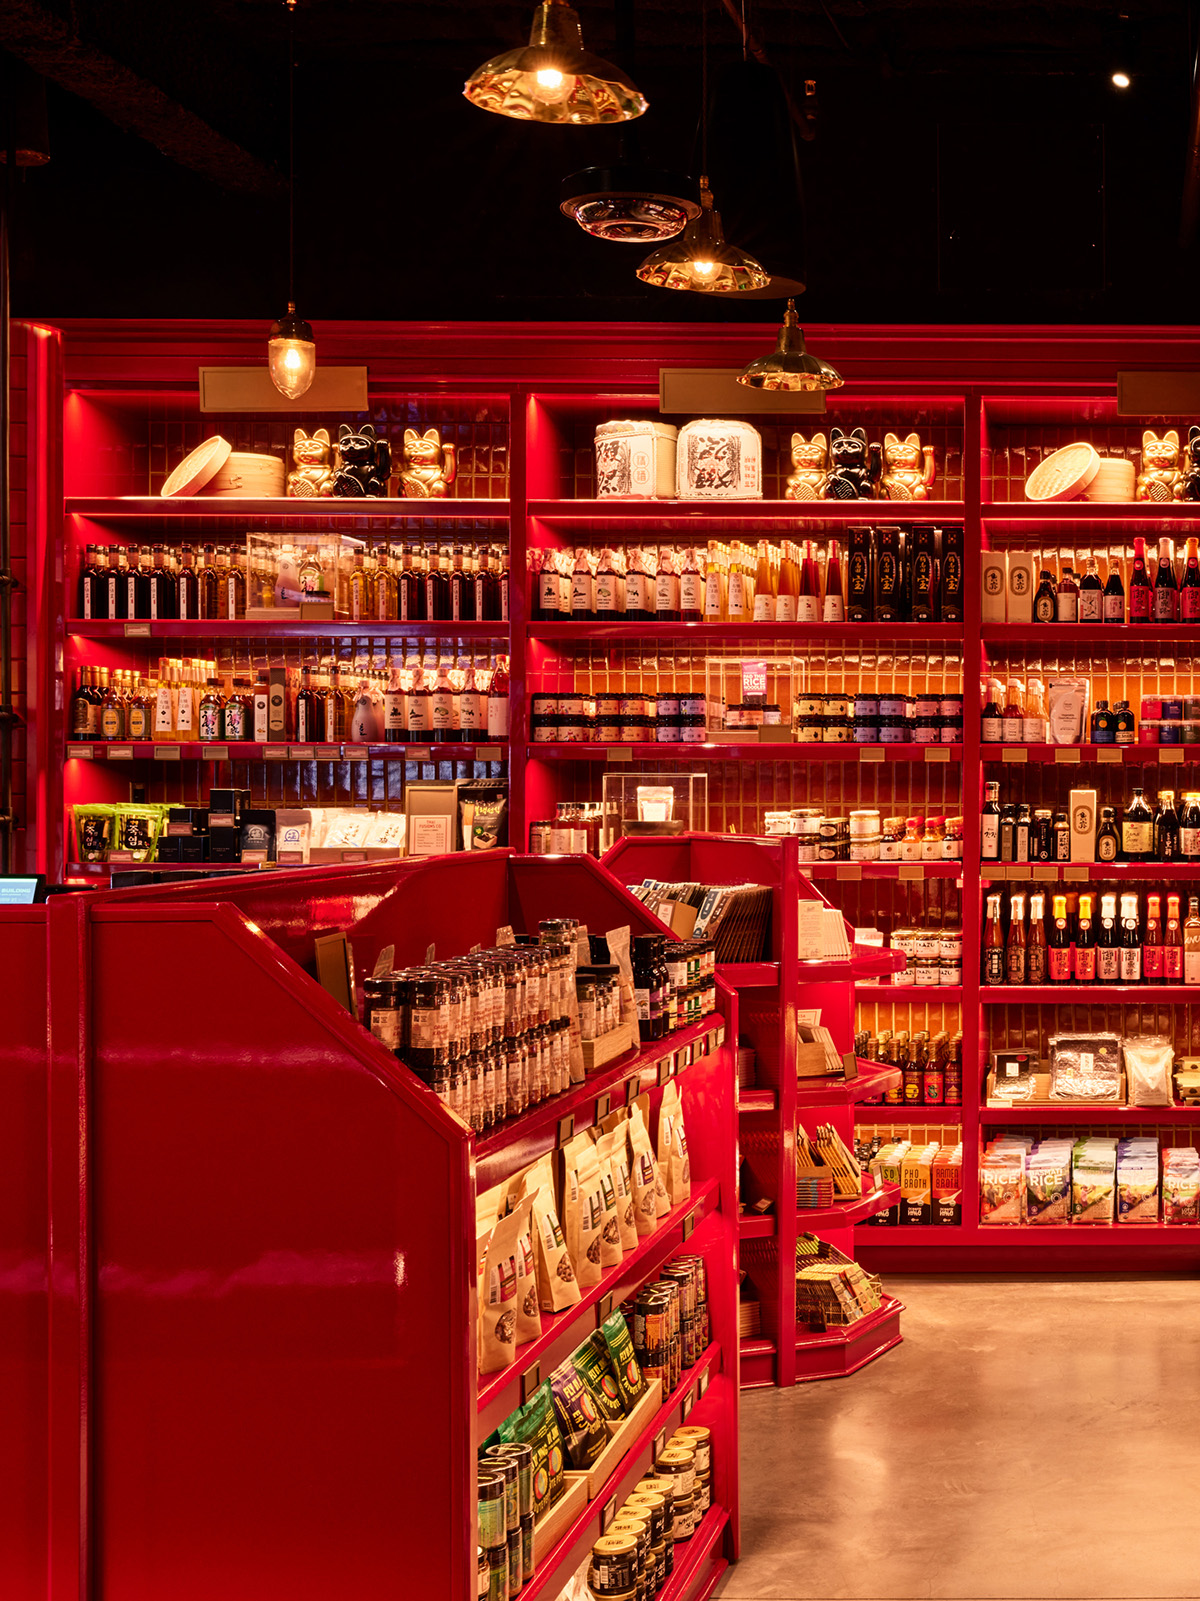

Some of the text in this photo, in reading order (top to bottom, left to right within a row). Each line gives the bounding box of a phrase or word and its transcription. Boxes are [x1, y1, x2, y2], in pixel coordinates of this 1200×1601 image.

[905, 1169, 919, 1178] PHO
[936, 1169, 959, 1178] RAMEN
[936, 1179, 959, 1188] BROTH
[984, 1173, 1017, 1185] RICE
[1030, 1175, 1063, 1186] RICE
[905, 1179, 927, 1189] BROTH
[1168, 1181, 1196, 1189] RICE
